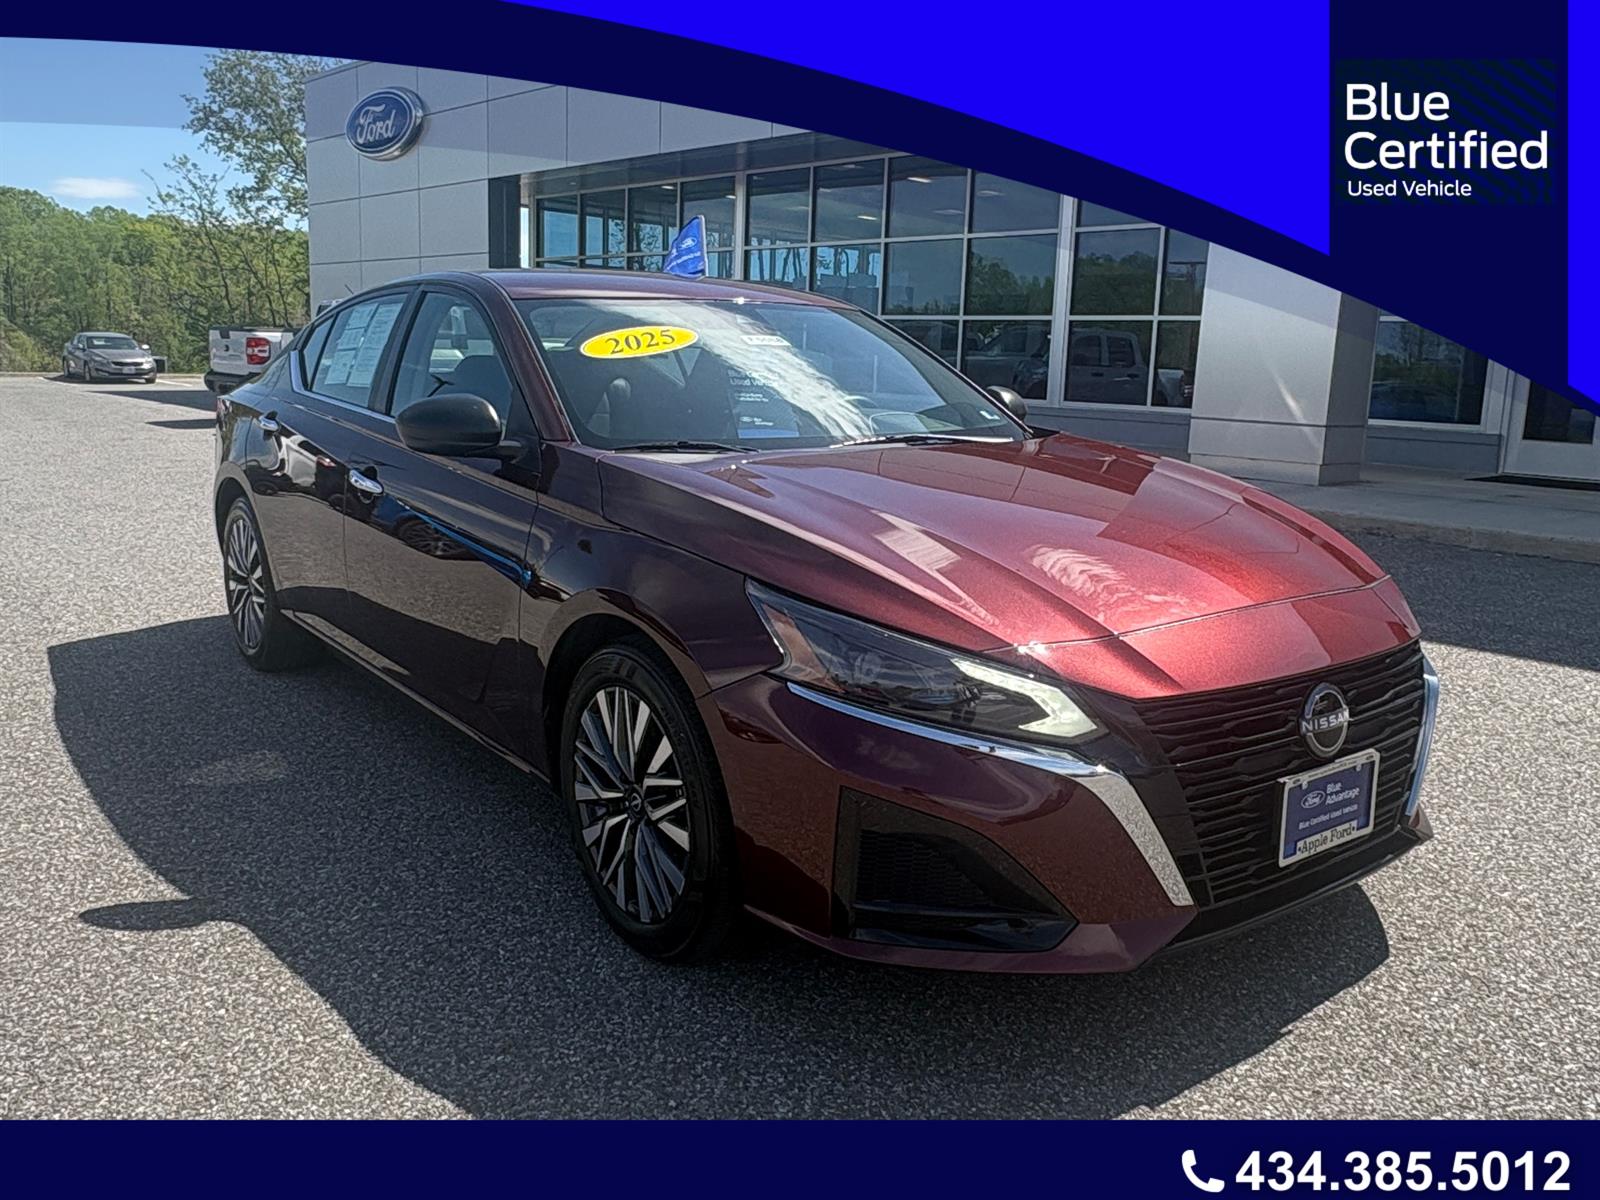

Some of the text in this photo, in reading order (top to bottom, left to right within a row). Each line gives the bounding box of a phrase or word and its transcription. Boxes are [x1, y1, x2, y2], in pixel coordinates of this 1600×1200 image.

[356, 104, 396, 145] Ford
[604, 329, 676, 355] 2025
[1301, 710, 1349, 732] NISSAN
[1325, 787, 1361, 805] Advantage
[1301, 823, 1353, 854] Apple Ford
